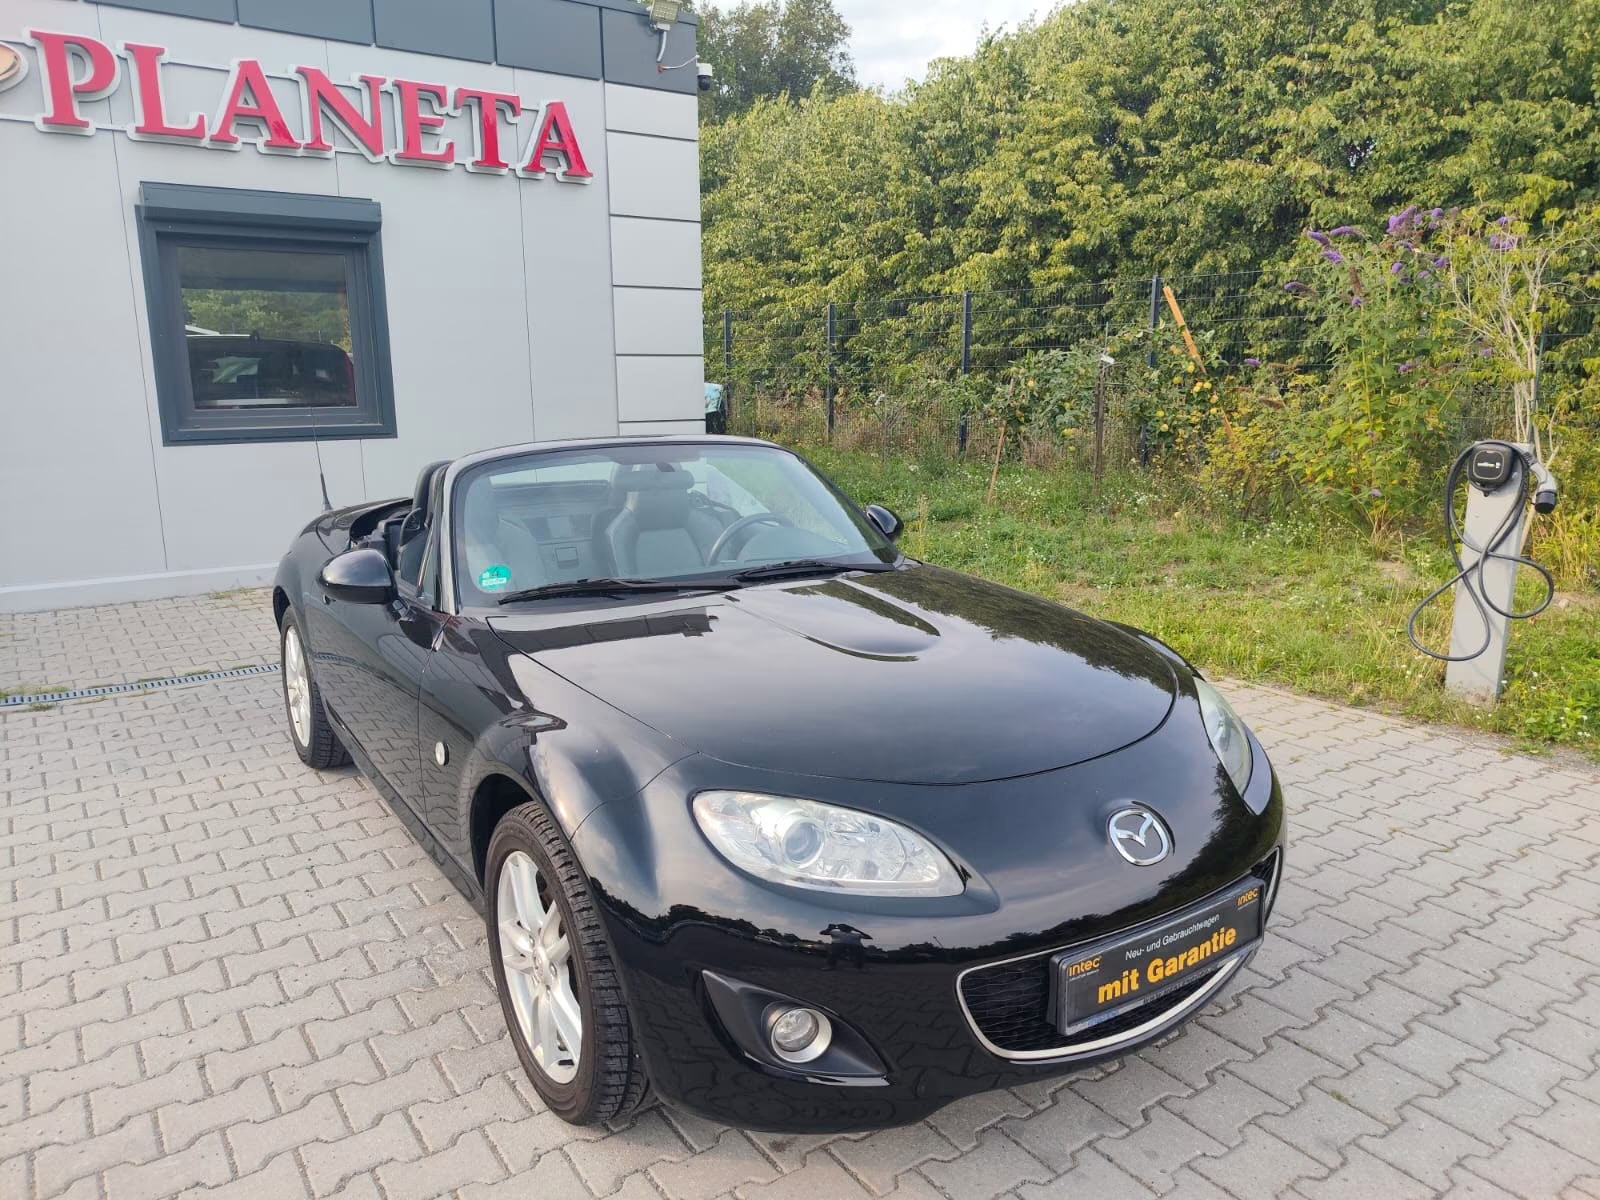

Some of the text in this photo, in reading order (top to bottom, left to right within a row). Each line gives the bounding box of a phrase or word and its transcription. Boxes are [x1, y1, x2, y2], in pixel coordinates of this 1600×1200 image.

[30, 30, 593, 181] PLANETA
[491, 567, 500, 577] 4
[1237, 887, 1259, 907] intec
[1125, 913, 1220, 961] Neu- und Gebrauchtwagen
[1068, 956, 1102, 977] intec
[1097, 968, 1140, 1004] mit
[1146, 926, 1237, 983] Garantie
